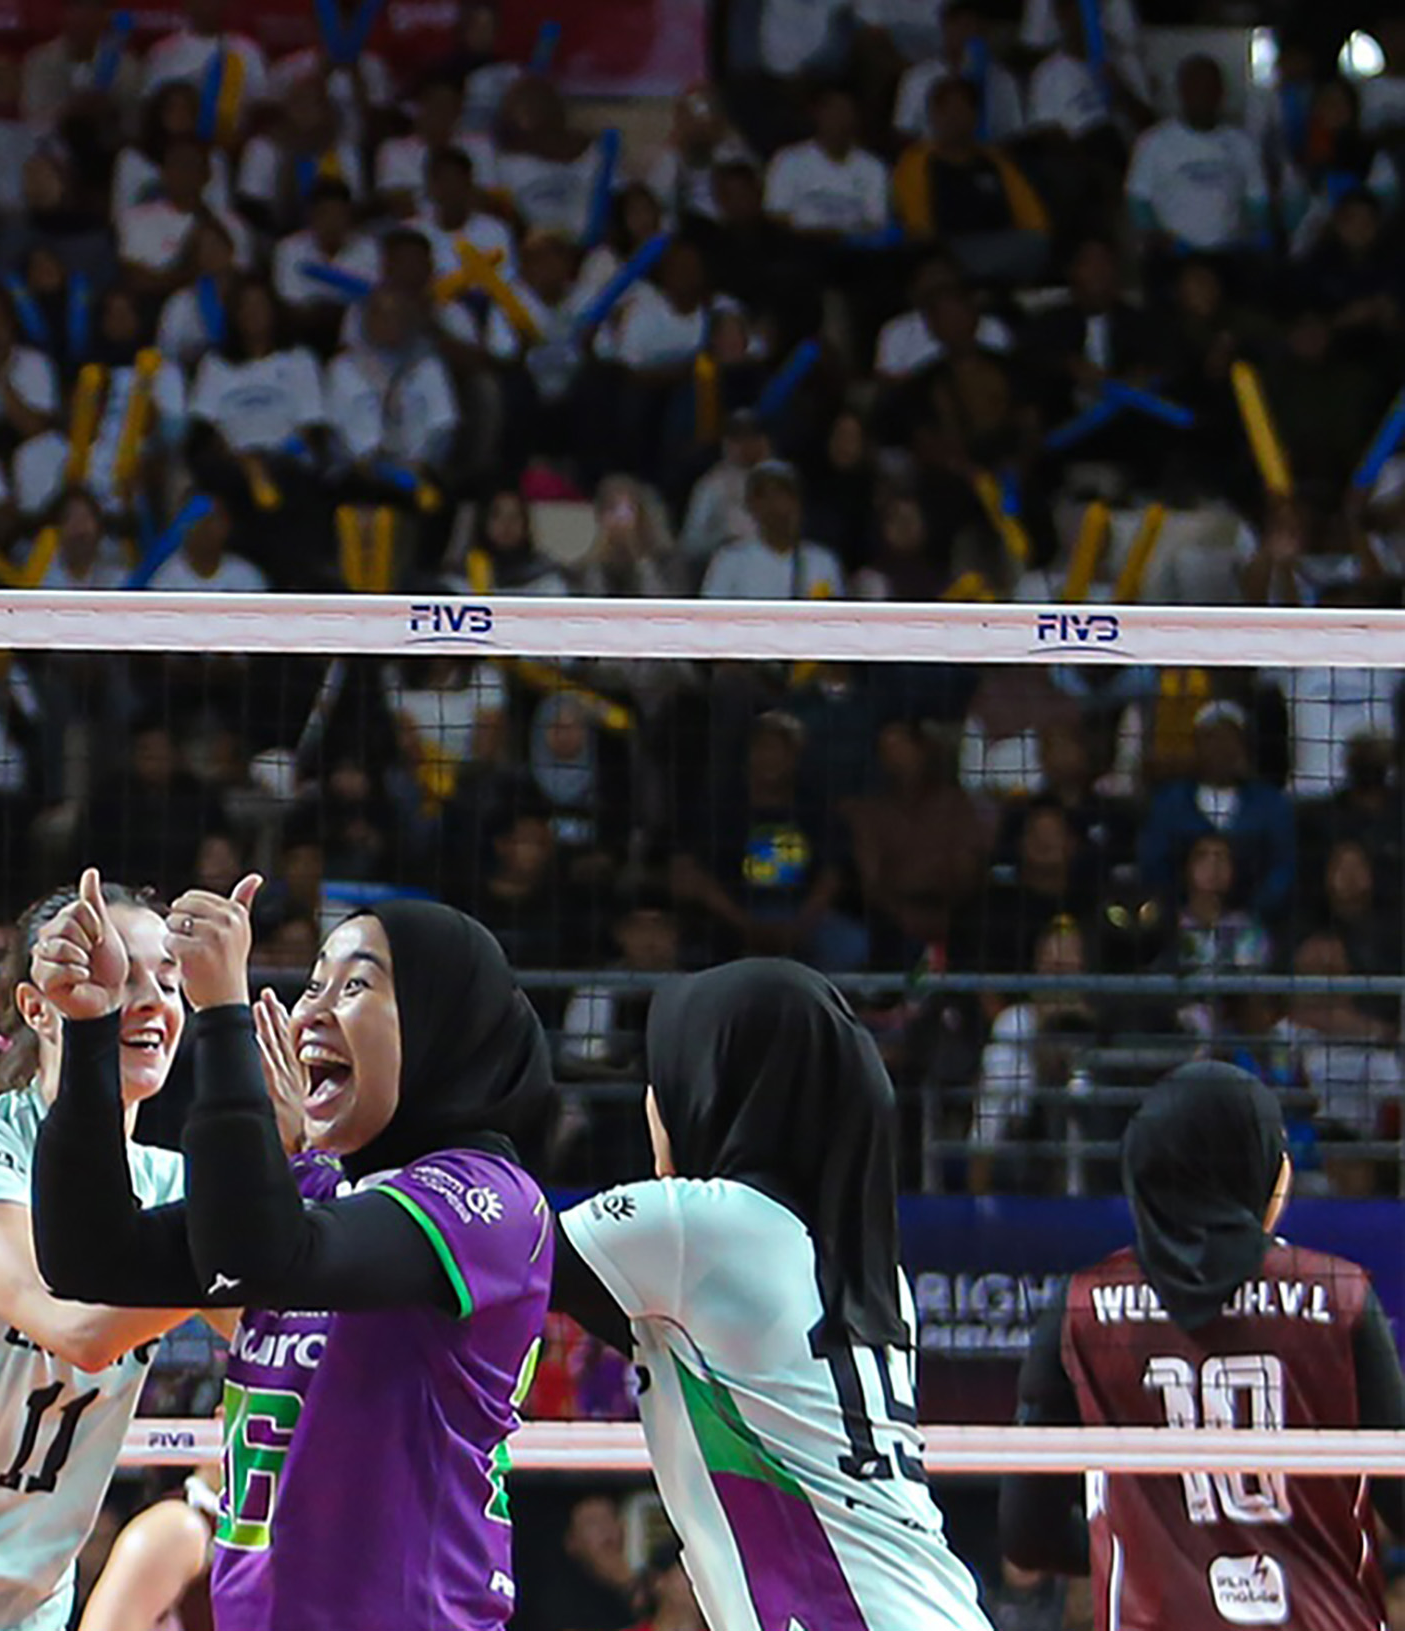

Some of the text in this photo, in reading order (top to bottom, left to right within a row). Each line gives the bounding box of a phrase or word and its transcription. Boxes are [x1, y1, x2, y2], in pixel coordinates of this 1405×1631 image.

[410, 604, 493, 632] FIVB
[1037, 614, 1119, 641] FIVB
[1144, 1354, 1292, 1523] 10
